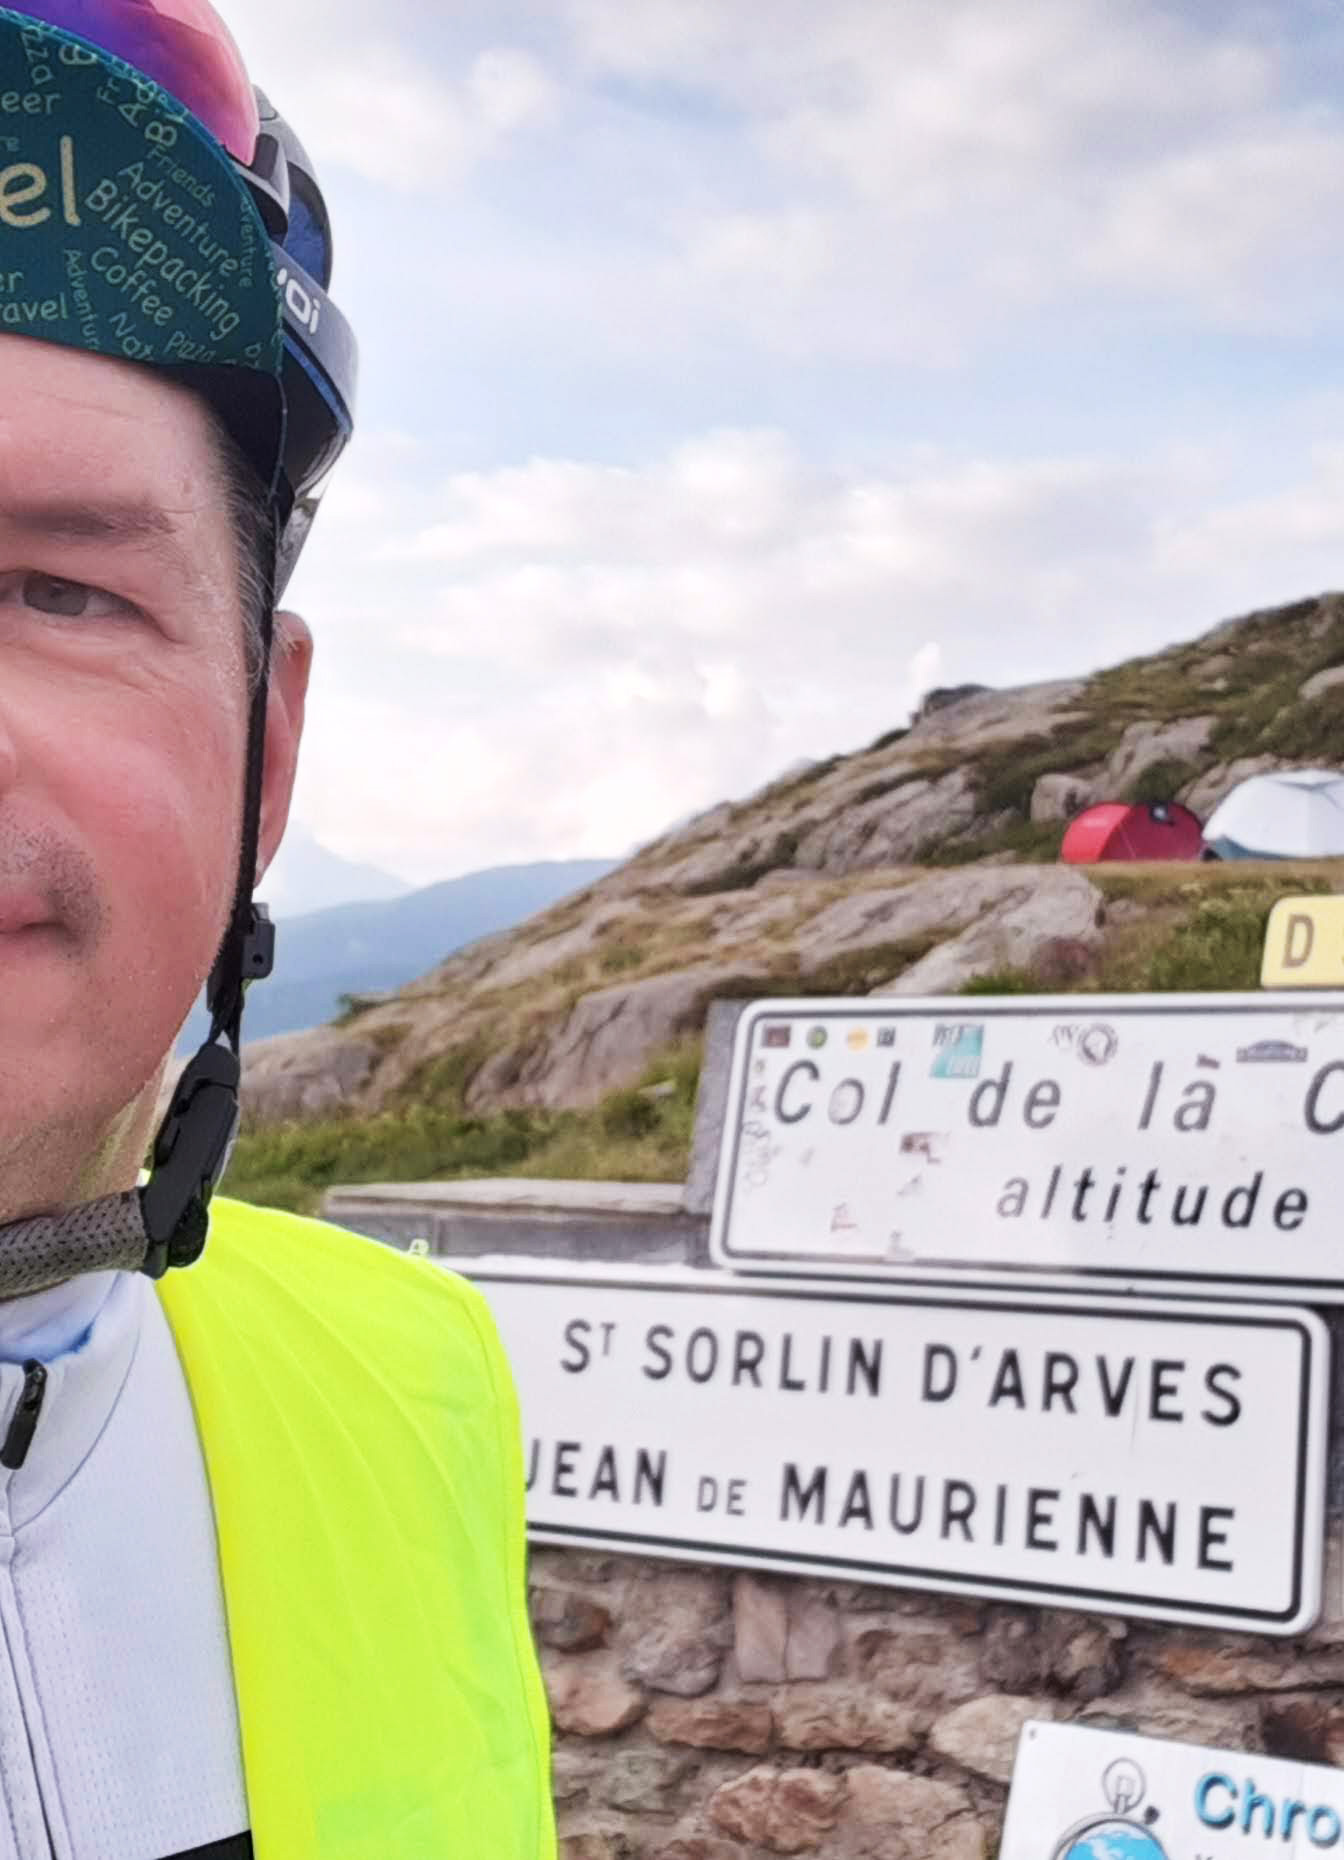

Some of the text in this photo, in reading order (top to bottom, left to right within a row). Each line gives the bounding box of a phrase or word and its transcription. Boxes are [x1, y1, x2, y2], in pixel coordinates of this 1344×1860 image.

[146, 147, 216, 208] Friends
[117, 161, 239, 277] Adventure
[84, 179, 241, 342] Bikepacking
[91, 247, 173, 327] Coffee
[1282, 912, 1316, 968] D
[773, 1058, 901, 1126] Col
[967, 1060, 1062, 1131] de
[996, 1165, 1311, 1231] altitude
[642, 1322, 884, 1398] SORLIN
[921, 1343, 1244, 1428] D'ARVES
[525, 1437, 1238, 1574] JEAN DE MAURIENNE
